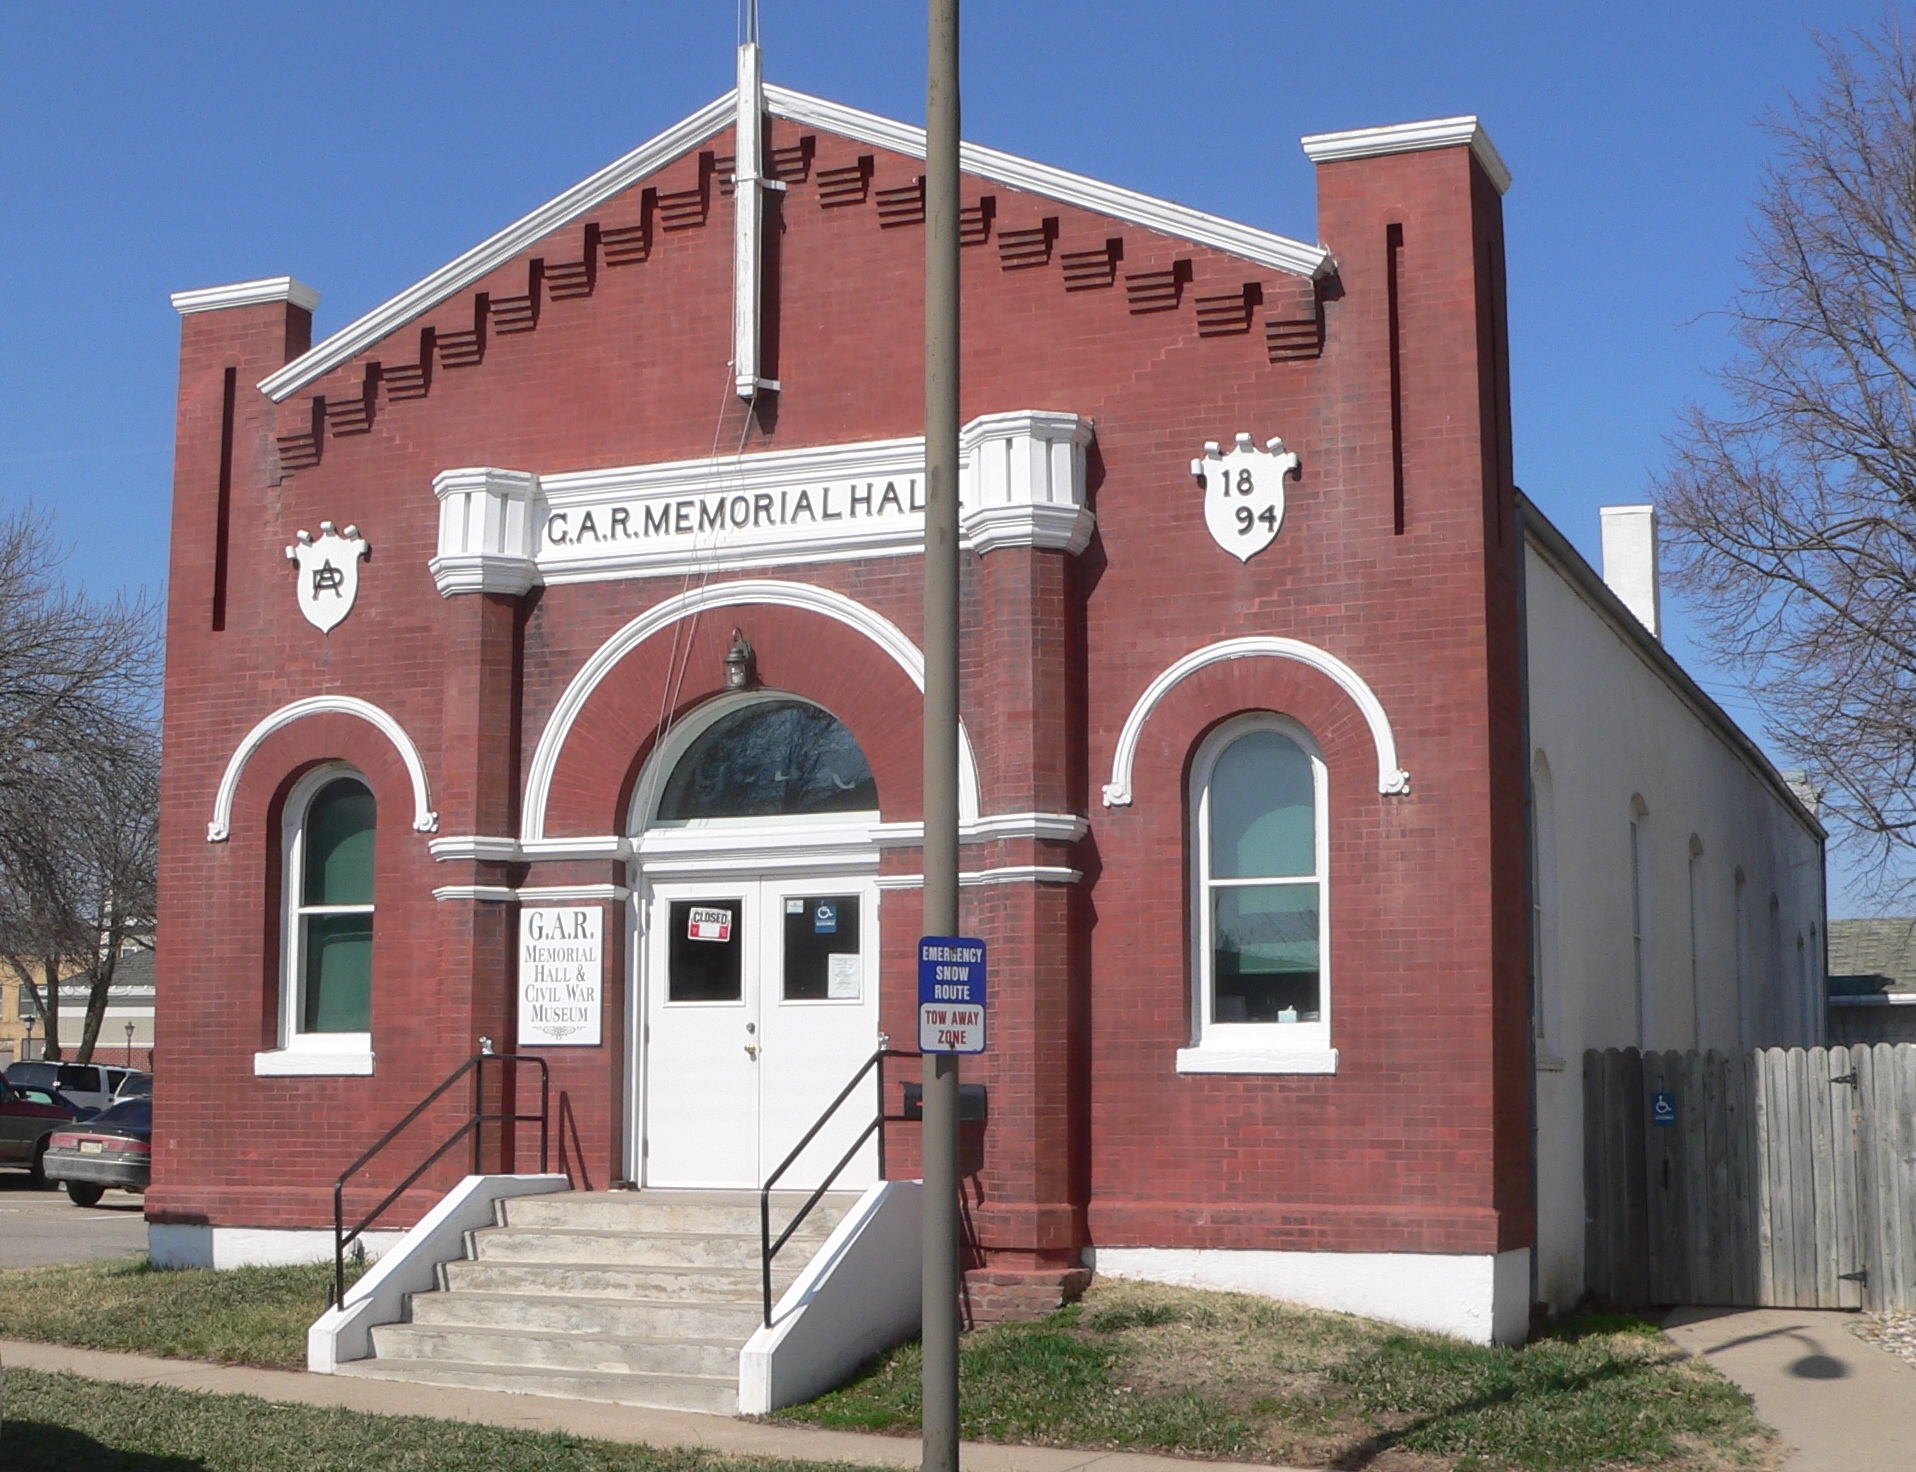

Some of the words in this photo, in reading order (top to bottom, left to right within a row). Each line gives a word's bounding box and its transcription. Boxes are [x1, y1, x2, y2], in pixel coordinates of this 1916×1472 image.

[1221, 468, 1254, 497] 18
[548, 507, 639, 546] G.A.R.
[643, 486, 843, 537] MEMORIAL
[1235, 504, 1277, 536] 94
[529, 911, 595, 941] G.A.R.
[693, 911, 728, 925] CLOSED
[525, 945, 596, 963] MEMORIAL
[922, 946, 982, 963] EMERGENCY
[534, 964, 571, 982] HALL
[576, 964, 586, 982] &
[936, 966, 969, 981] SNOW
[525, 984, 561, 1002] CIVIL
[566, 984, 595, 1002] WAR
[934, 985, 970, 1000] ROUTE
[531, 1004, 588, 1022] MUSEUM
[925, 1010, 947, 1025] TOW
[951, 1011, 979, 1026] AWAY
[938, 1030, 966, 1045] ZONE
